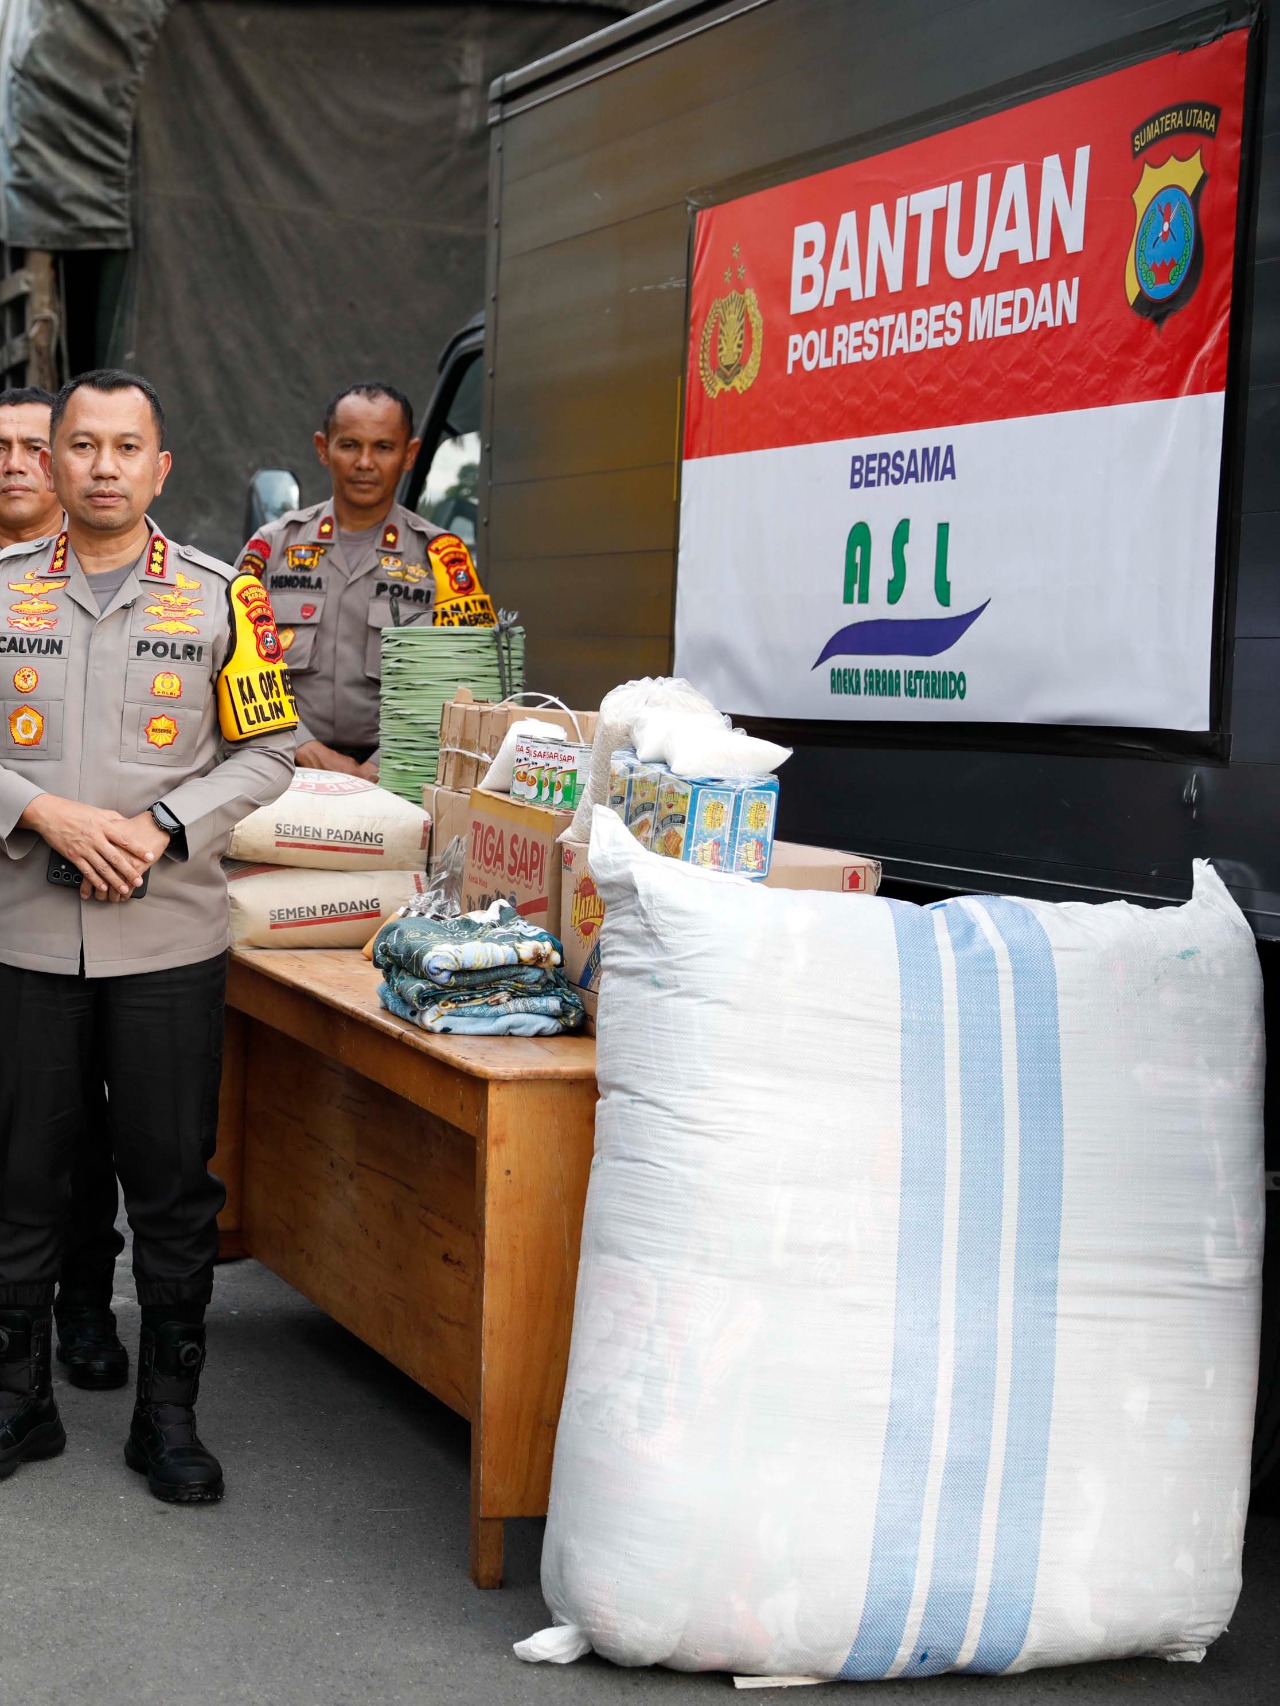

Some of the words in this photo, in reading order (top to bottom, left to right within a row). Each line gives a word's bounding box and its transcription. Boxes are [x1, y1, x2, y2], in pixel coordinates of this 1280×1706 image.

[1133, 110, 1183, 151] SUMATERA
[1185, 108, 1216, 132] UTARA
[789, 145, 1091, 315] BANTUAN
[786, 301, 961, 375] POLRESTABES
[968, 276, 1079, 342] MEDAN
[849, 444, 957, 490] BERSAMA
[842, 518, 951, 608] ASL
[375, 582, 431, 605] POLRI
[136, 640, 204, 662] POLRI
[237, 675, 257, 706] KA
[258, 670, 281, 701] OPS
[830, 667, 862, 696] ANEKA
[863, 668, 901, 698] SARANA
[903, 669, 967, 701] LESTARINDO
[244, 700, 286, 726] LILIN
[275, 823, 322, 839] SEMEN
[326, 828, 384, 844] PADANG
[472, 820, 505, 877] TIGA
[507, 833, 546, 890] SAPI
[269, 904, 317, 921] SEMEN
[321, 898, 381, 916] PADANG
